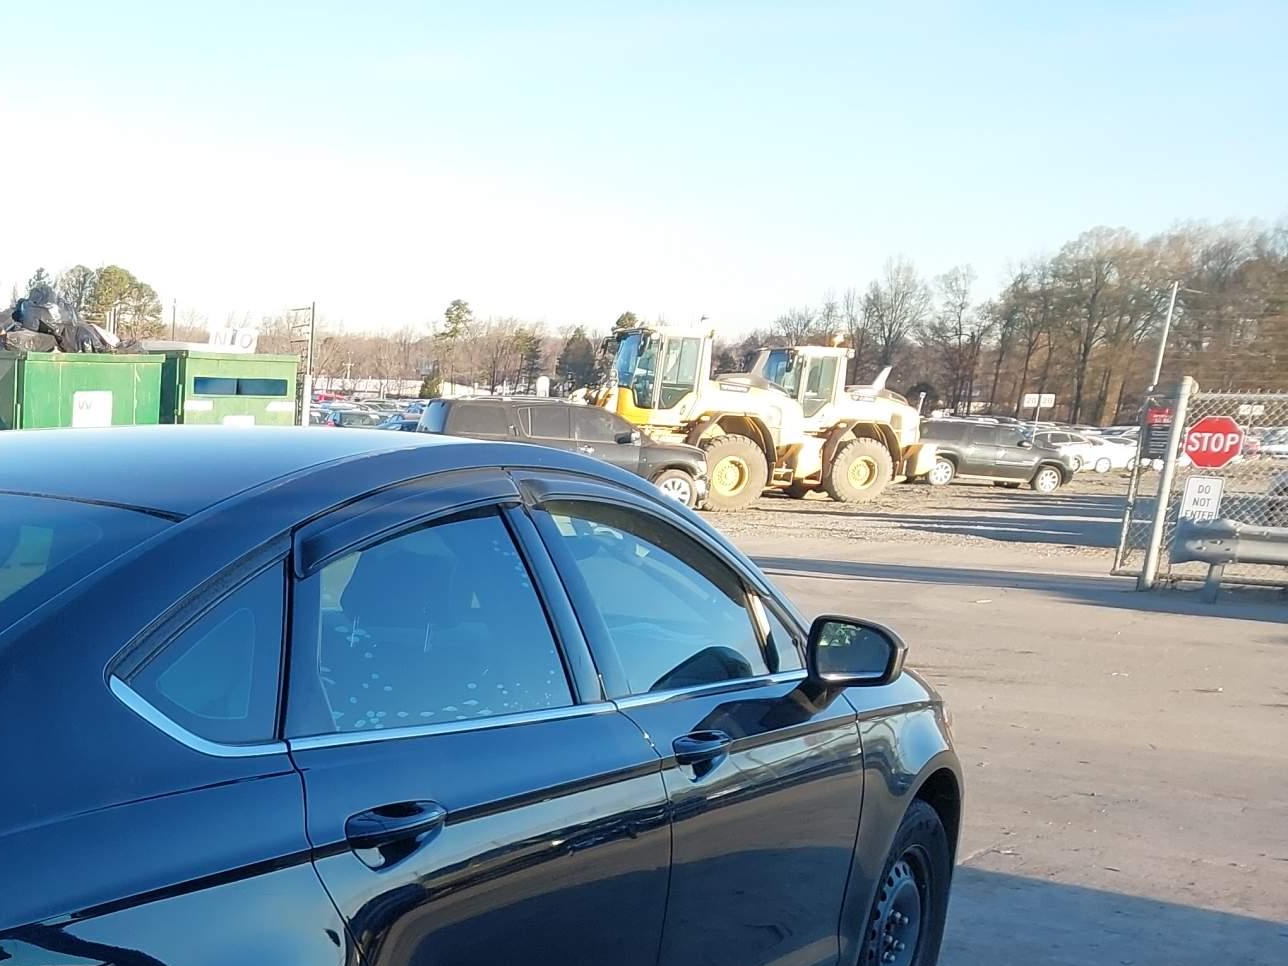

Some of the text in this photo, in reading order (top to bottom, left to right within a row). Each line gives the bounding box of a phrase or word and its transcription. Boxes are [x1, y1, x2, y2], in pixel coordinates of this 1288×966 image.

[1187, 432, 1239, 453] STOP
[1197, 484, 1211, 494] DO
[1192, 498, 1211, 508] NOT
[1185, 510, 1214, 519] ENTER
